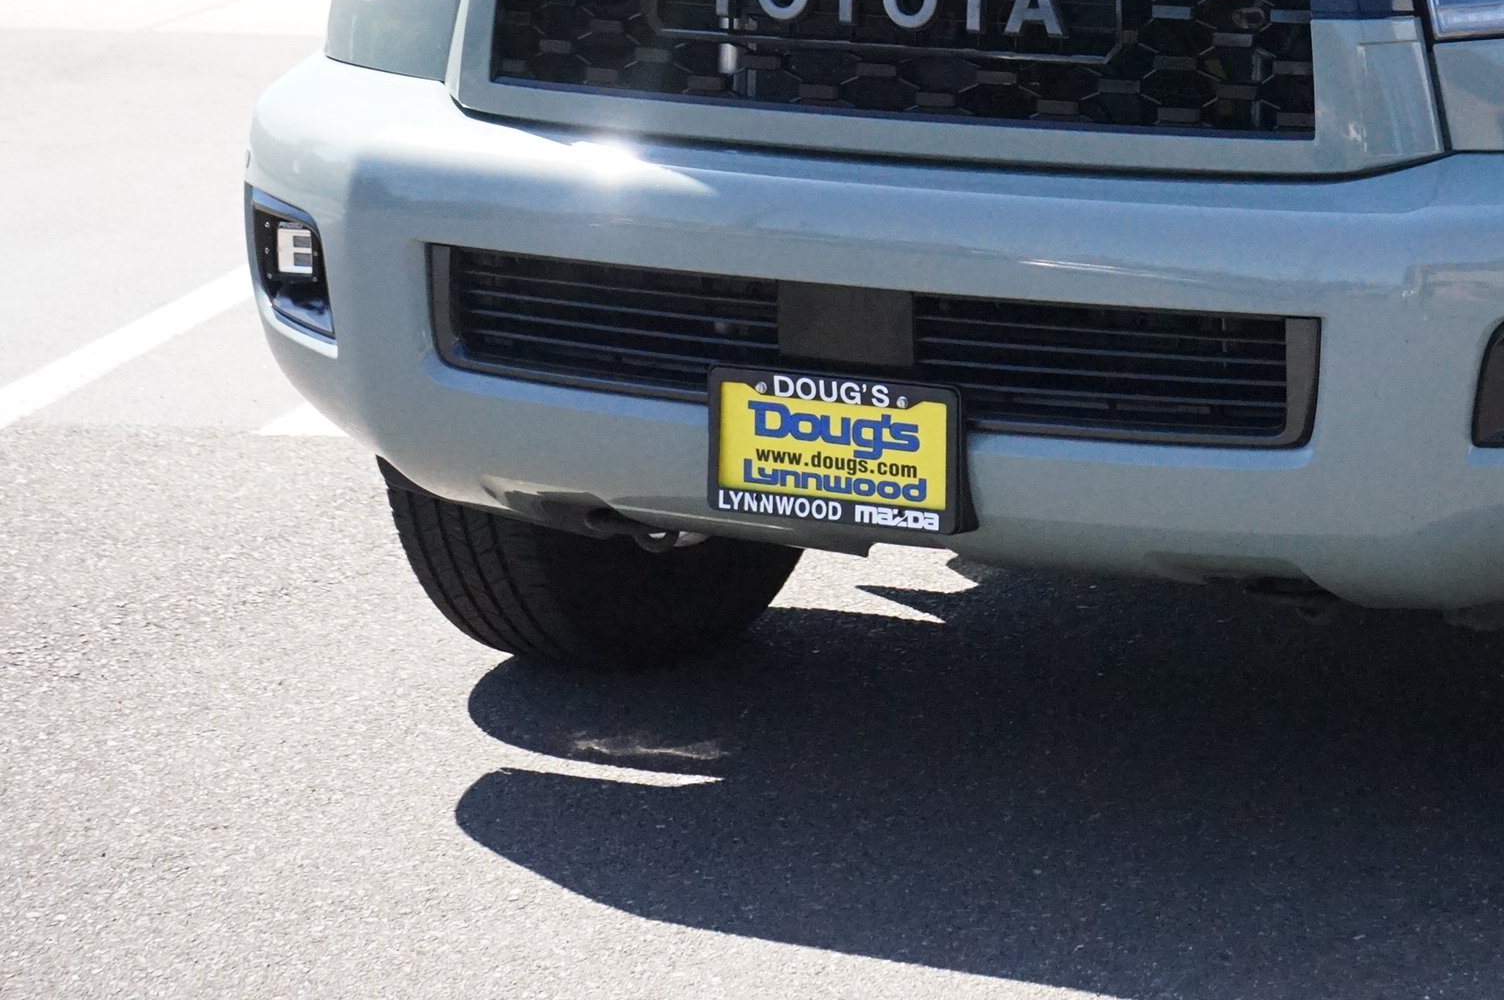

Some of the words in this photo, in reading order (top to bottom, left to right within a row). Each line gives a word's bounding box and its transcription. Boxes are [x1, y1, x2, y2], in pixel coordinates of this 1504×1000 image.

[773, 375, 890, 408] DOUG'S
[755, 448, 918, 479] www.dougs.com
[743, 458, 927, 503] Lynnwood
[718, 489, 842, 521] LYNNWOOD
